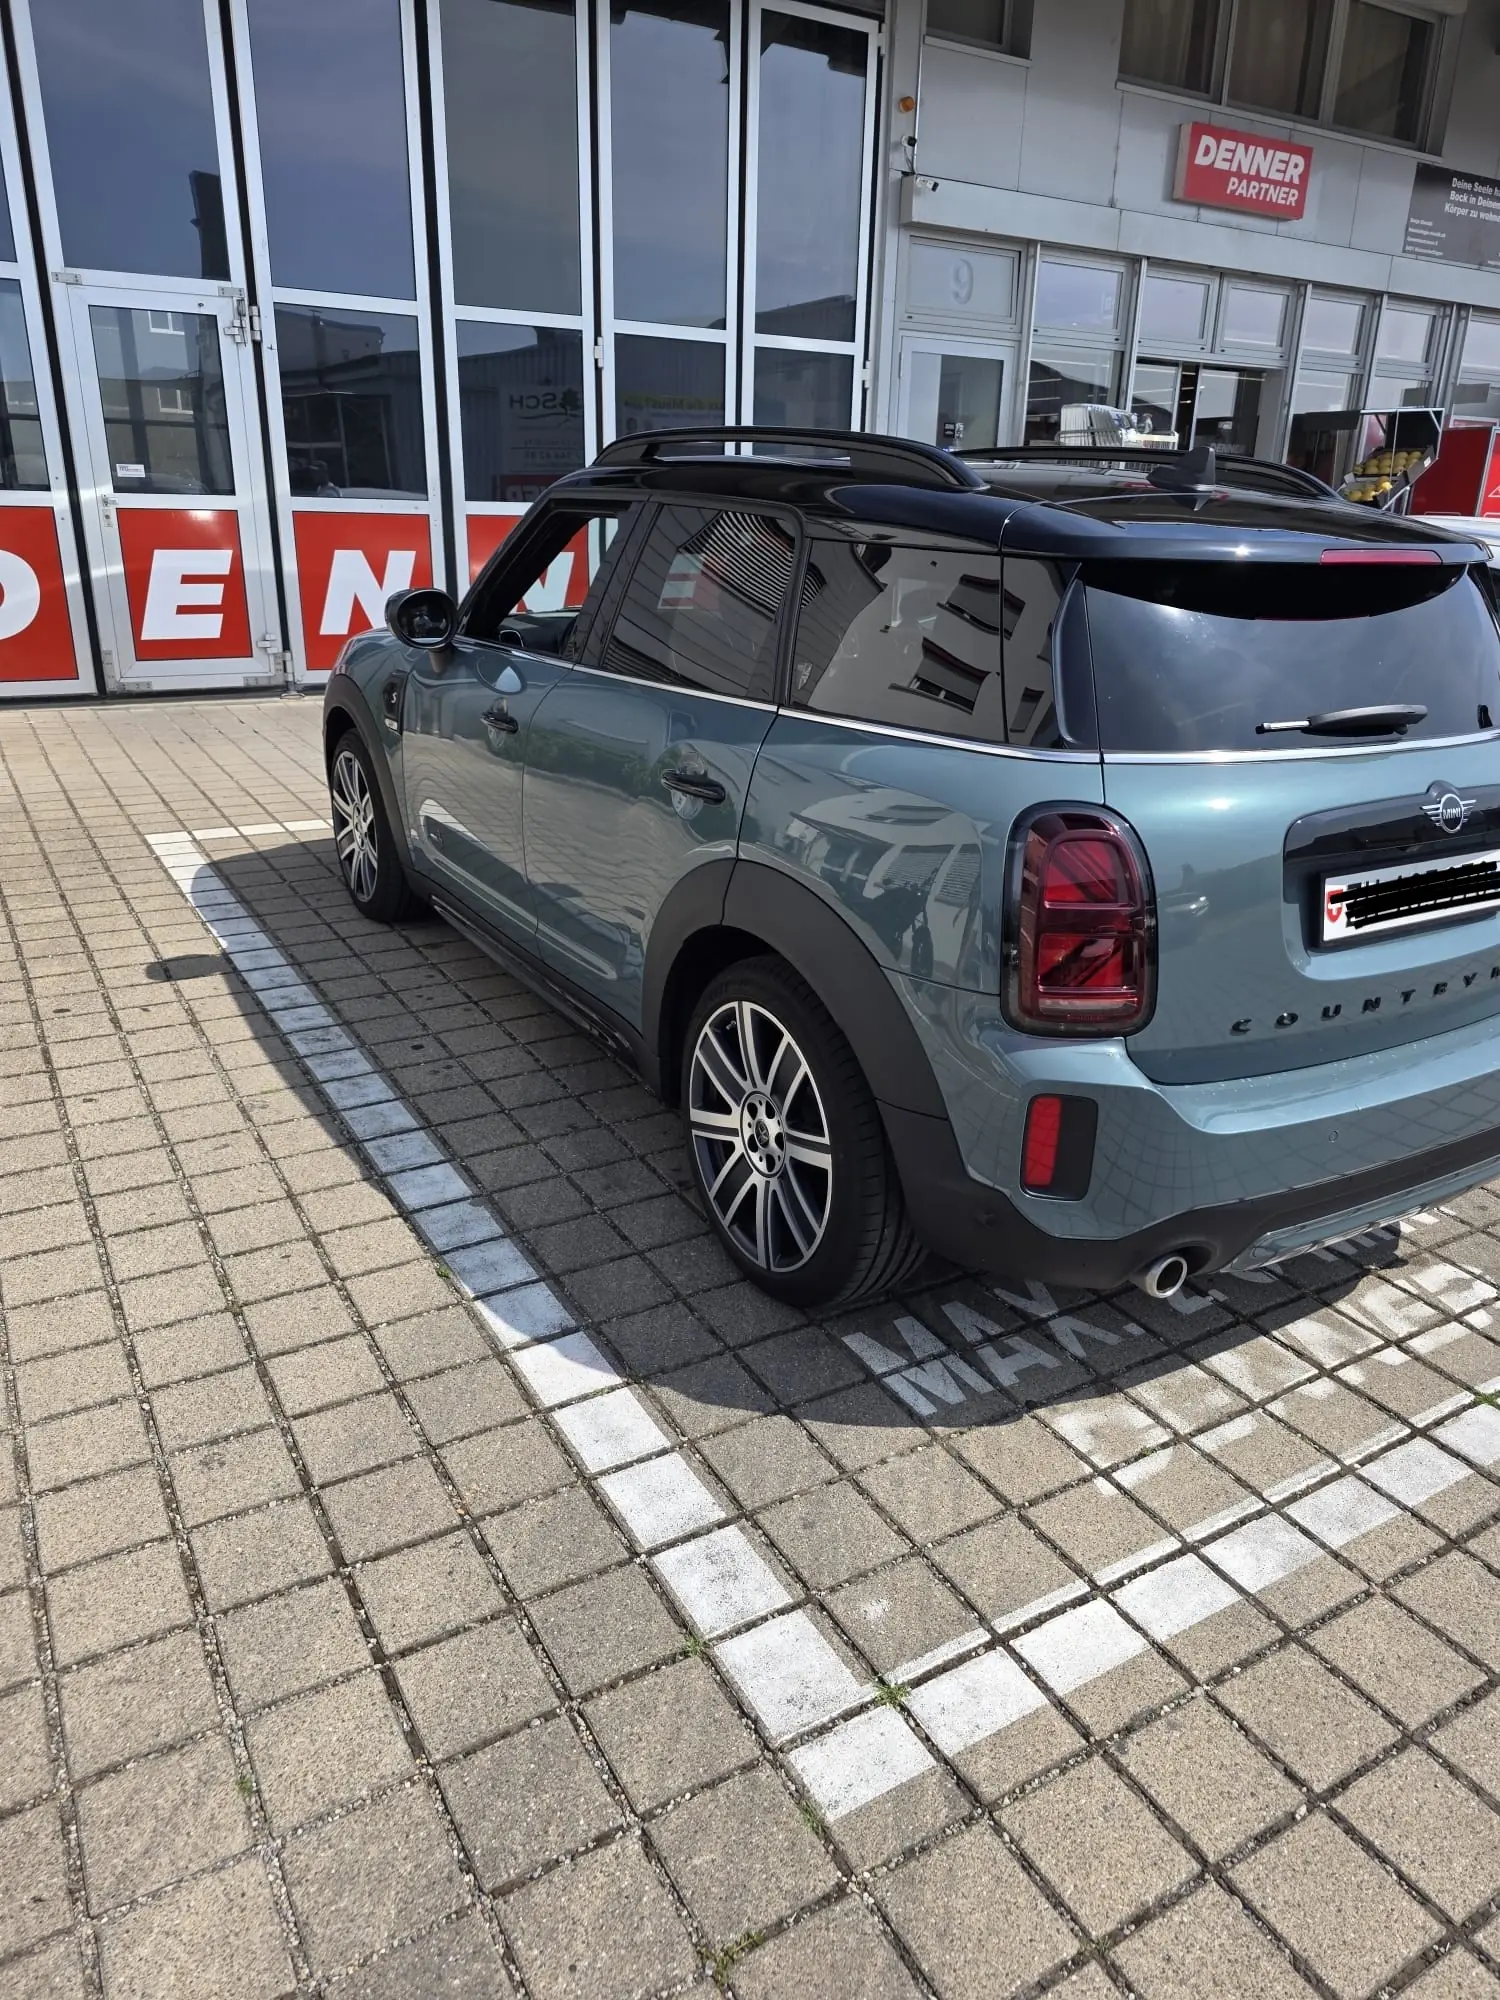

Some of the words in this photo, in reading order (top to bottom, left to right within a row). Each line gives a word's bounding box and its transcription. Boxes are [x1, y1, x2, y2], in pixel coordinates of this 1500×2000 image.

[1194, 134, 1305, 185] DENNER
[1226, 176, 1299, 206] PARTNER
[1451, 177, 1473, 191] Deine
[1473, 182, 1493, 195] Seele
[1449, 190, 1469, 203] Bock
[1469, 194, 1477, 205] in
[1444, 202, 1470, 217] Körper
[1469, 209, 1479, 218] zu
[952, 258, 974, 305] 9
[1442, 807, 1461, 820] MINI
